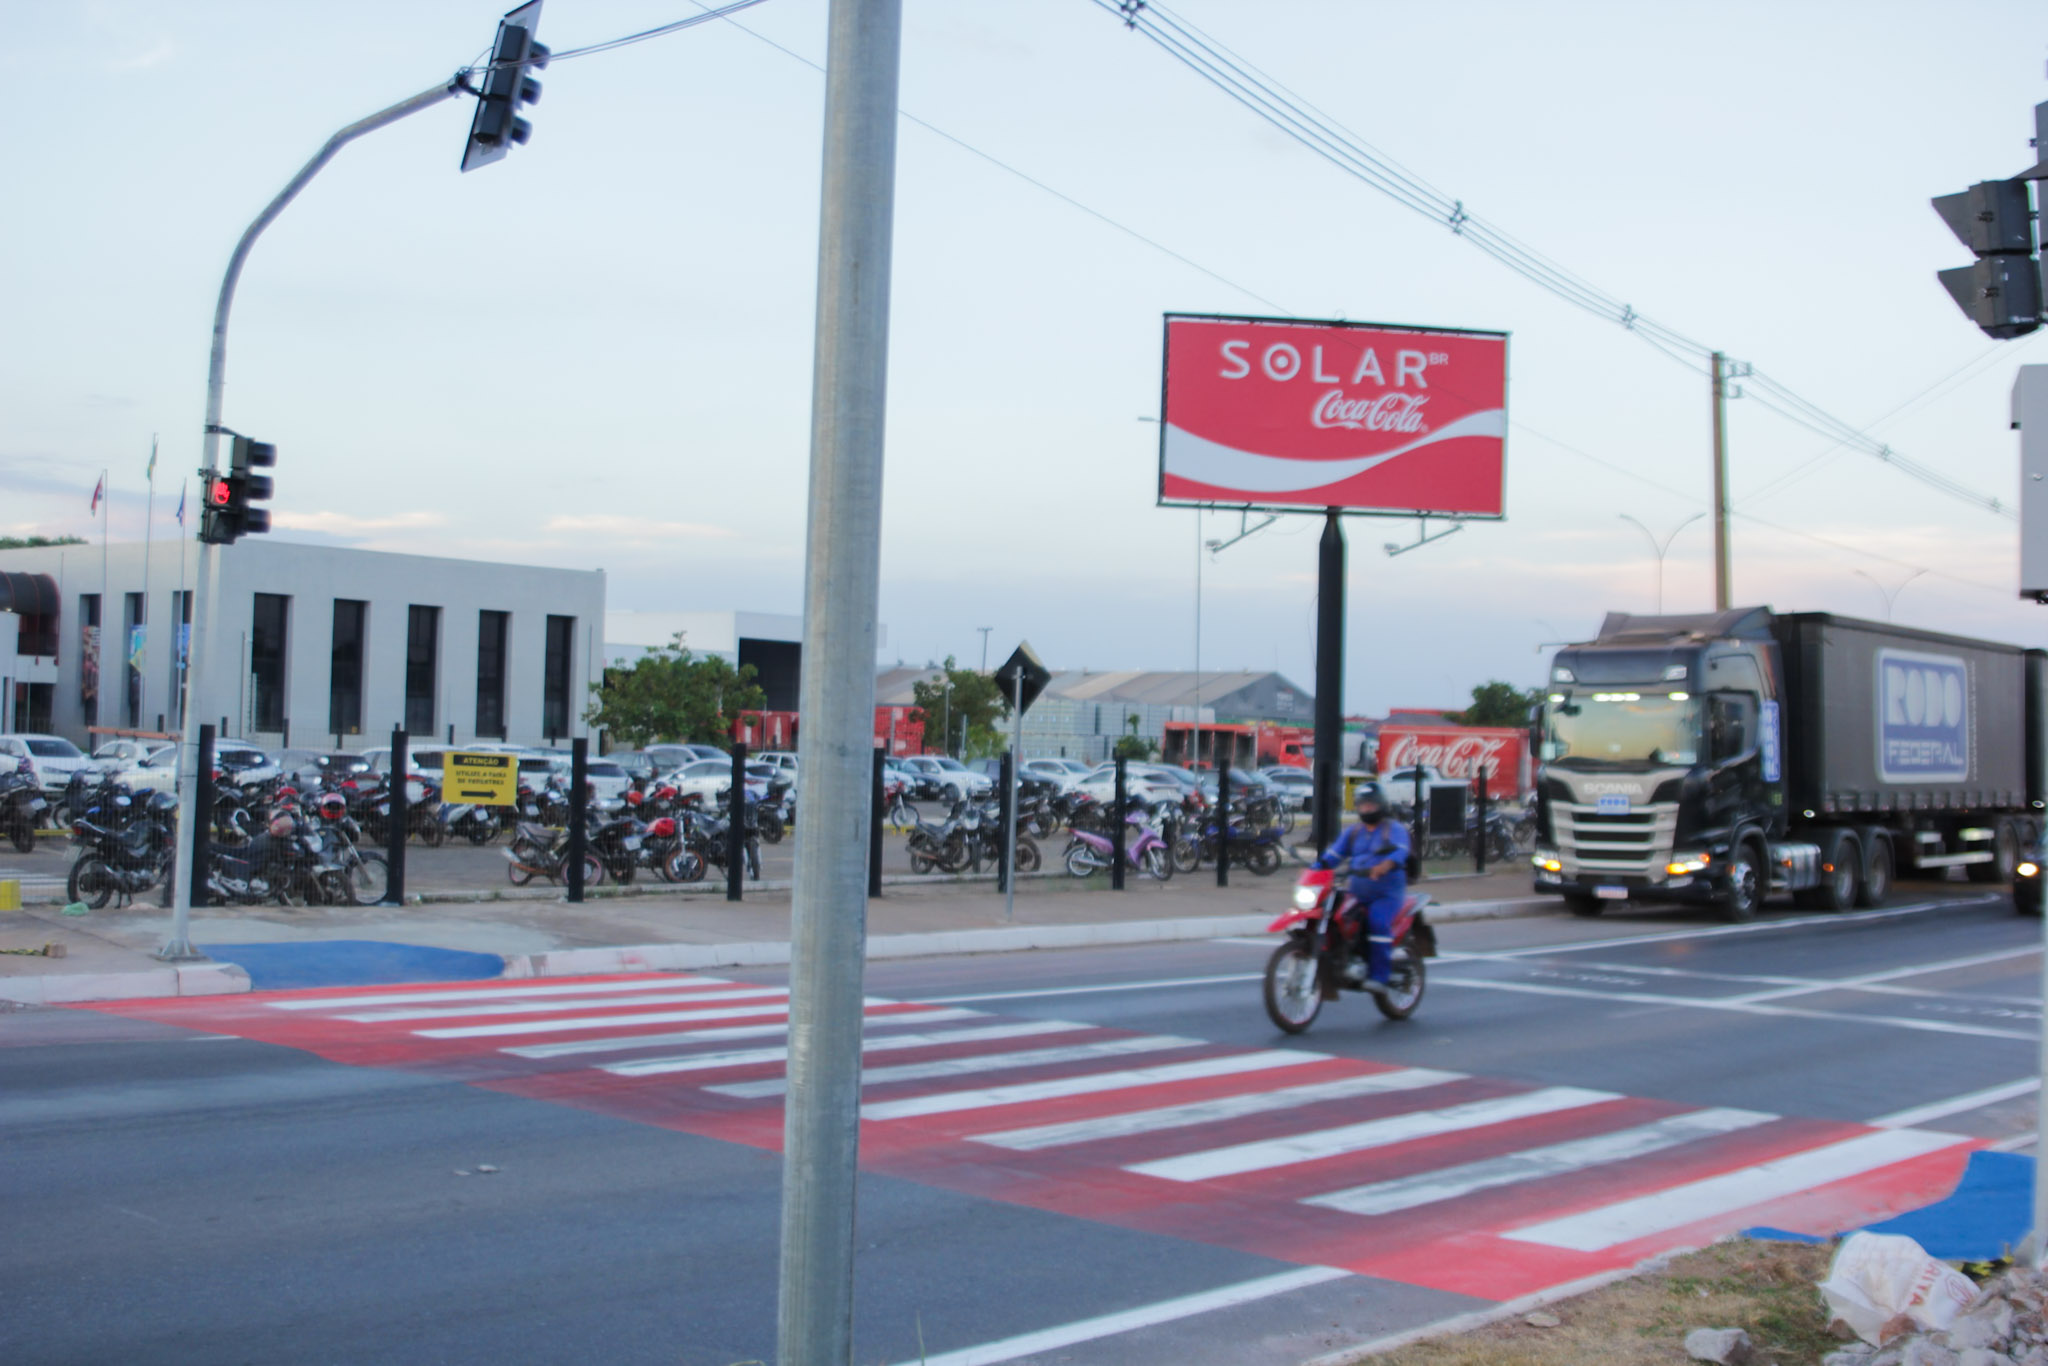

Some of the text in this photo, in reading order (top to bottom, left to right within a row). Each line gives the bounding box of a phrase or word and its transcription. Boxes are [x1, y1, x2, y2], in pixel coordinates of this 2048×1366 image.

[1219, 340, 1449, 388] SOLAR BR
[1311, 389, 1430, 434] Coca-Cola
[1886, 666, 1962, 729] RODO
[463, 757, 500, 767] ATENÇÃO
[1387, 734, 1507, 780] Coca-Cola
[1888, 740, 1964, 767] FEDERAL
[1583, 782, 1644, 795] SCANIA
